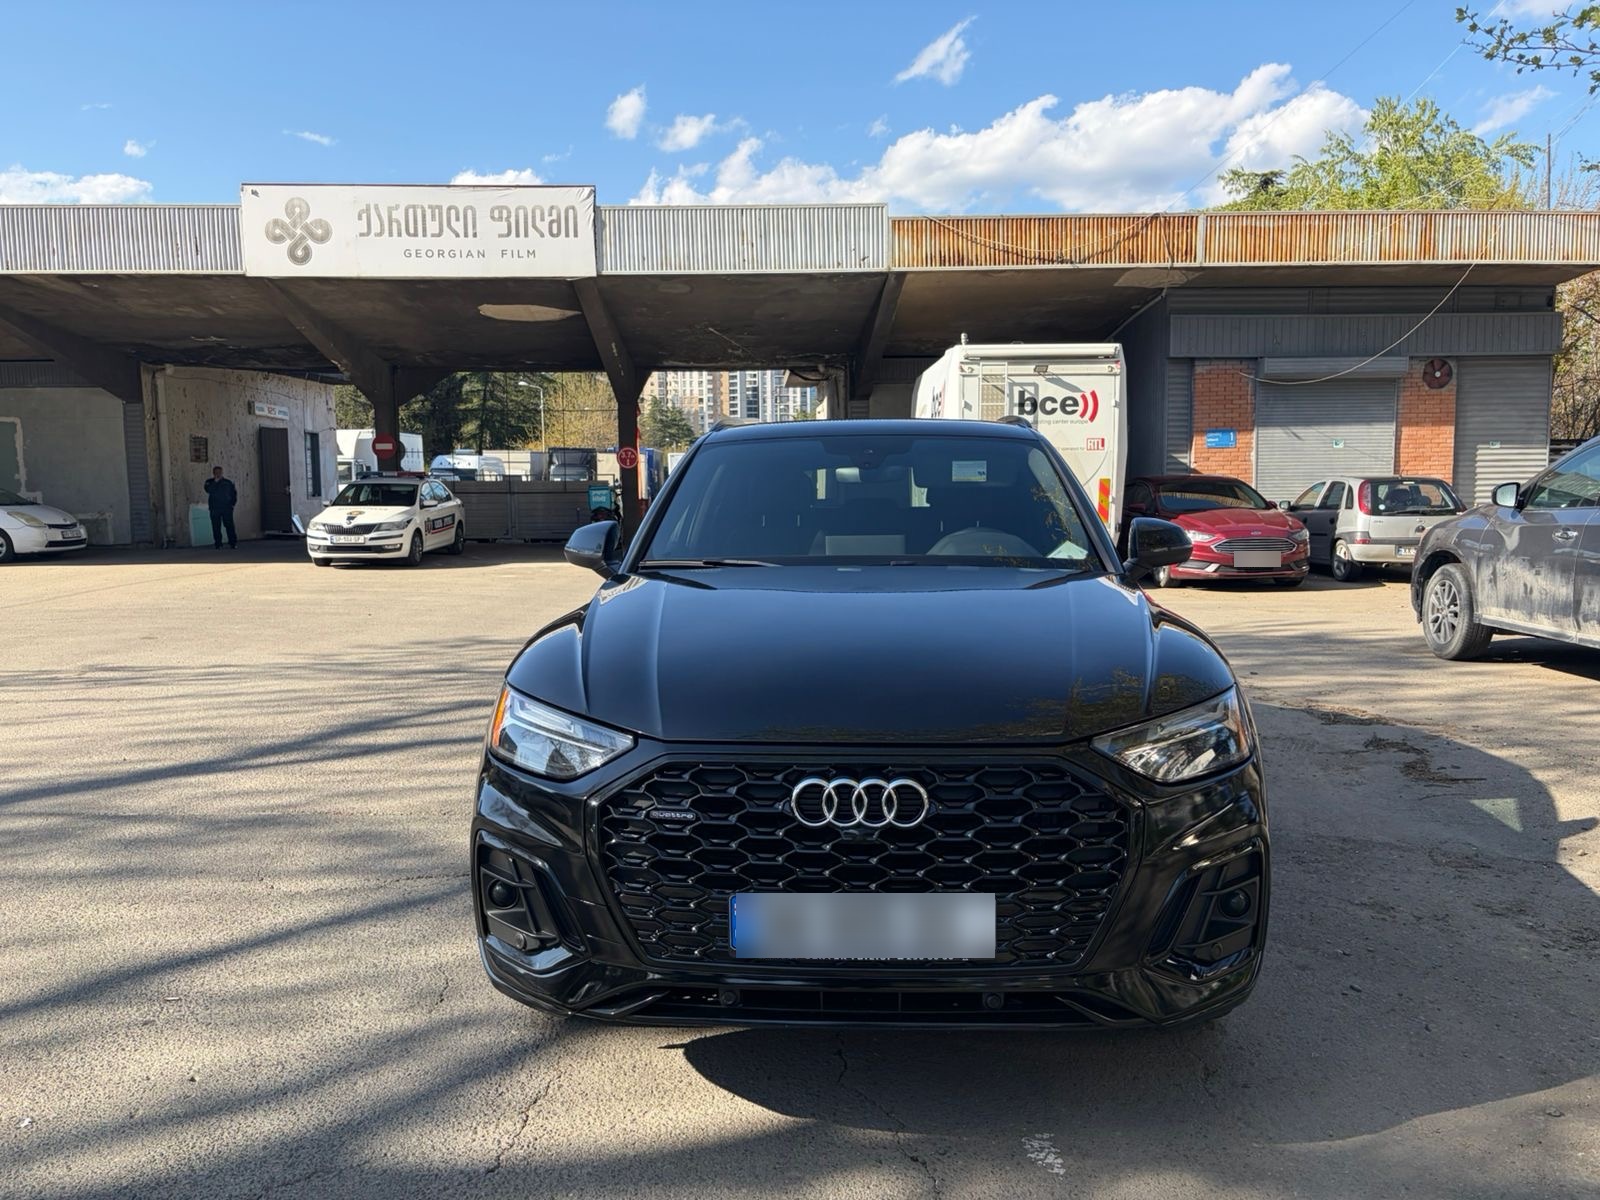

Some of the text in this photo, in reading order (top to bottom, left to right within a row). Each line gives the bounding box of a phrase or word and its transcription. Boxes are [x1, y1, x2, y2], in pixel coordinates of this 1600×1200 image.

[357, 203, 579, 238] ქართული ფილმი
[403, 248, 537, 259] GEORGIAN FILM
[1018, 390, 1079, 416] bce
[1087, 438, 1105, 451] RTL
